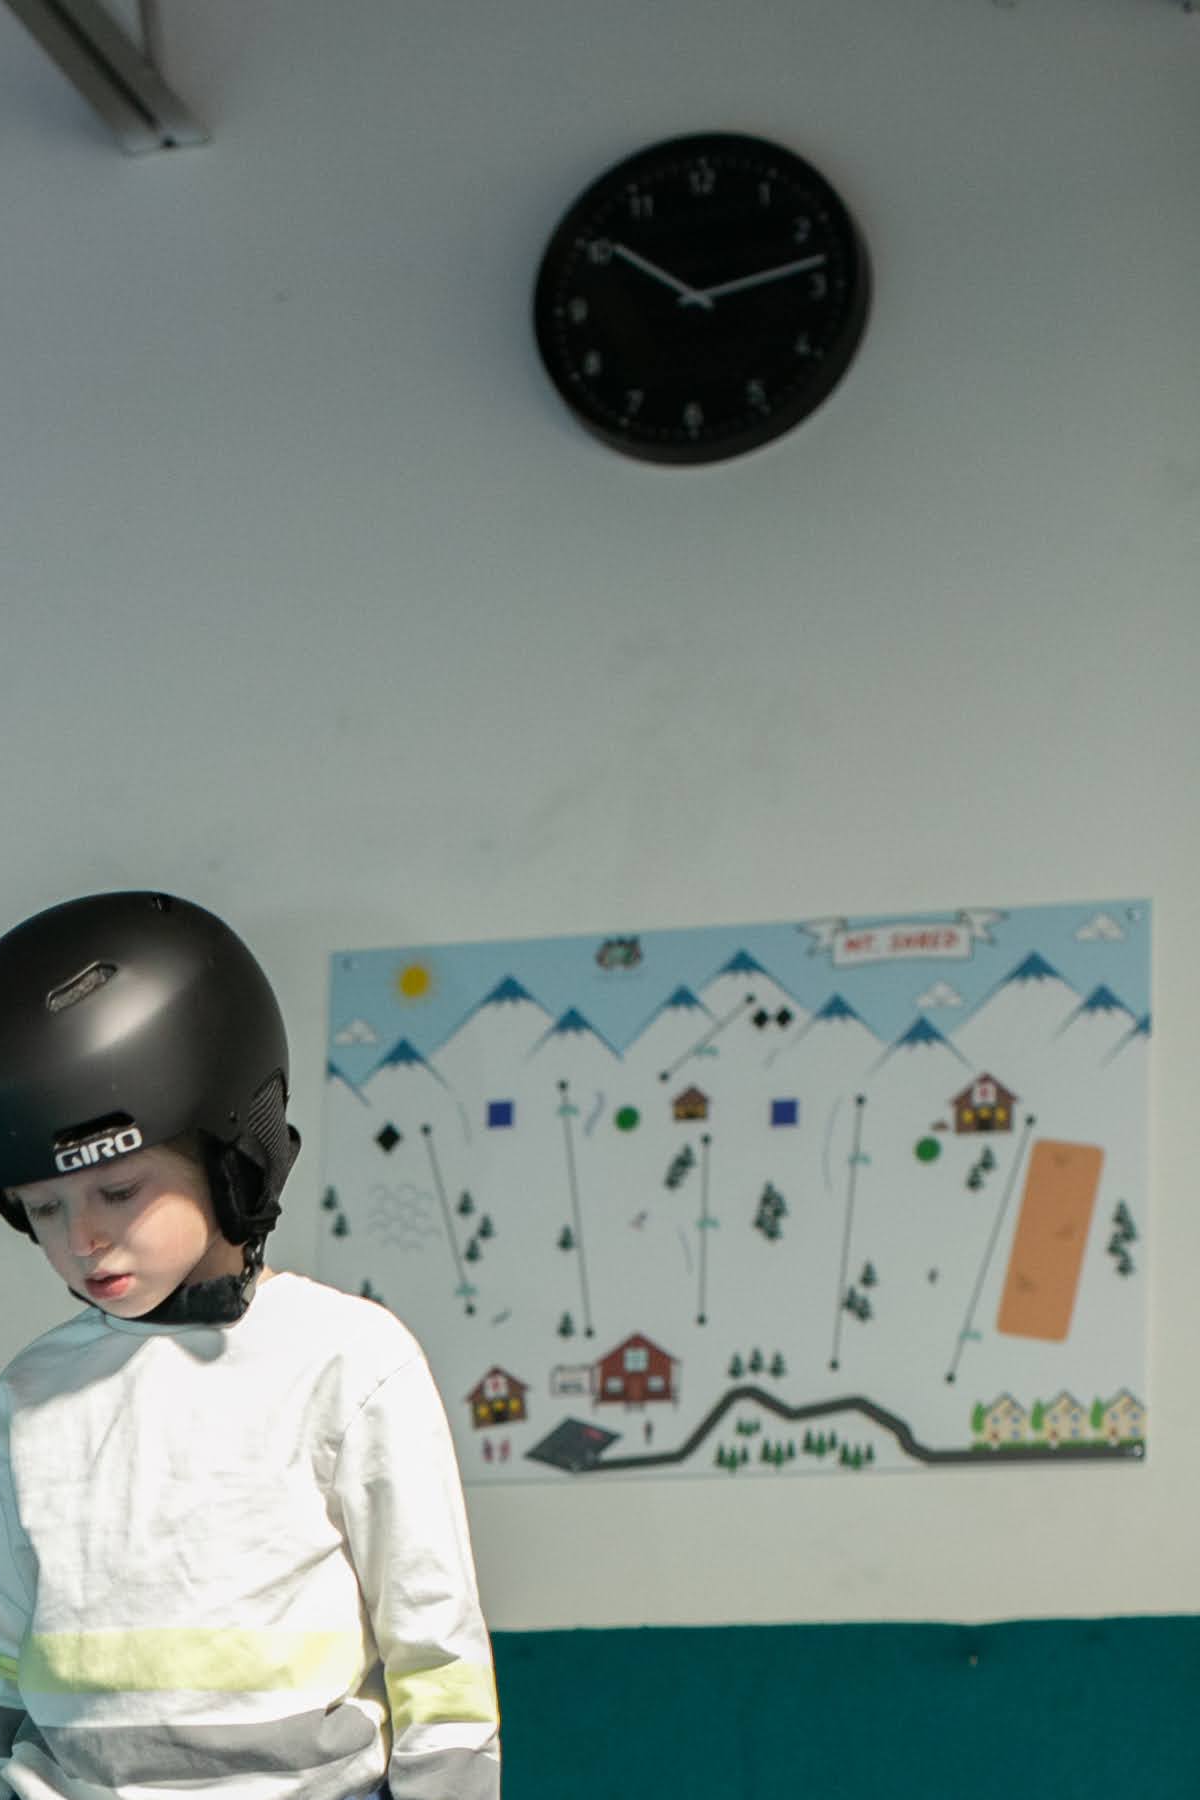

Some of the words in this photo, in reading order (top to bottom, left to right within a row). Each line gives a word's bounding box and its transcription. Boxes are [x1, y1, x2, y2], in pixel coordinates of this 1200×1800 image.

[688, 167, 717, 197] 12
[627, 193, 655, 219] 11
[55, 1127, 143, 1173] GIRO
